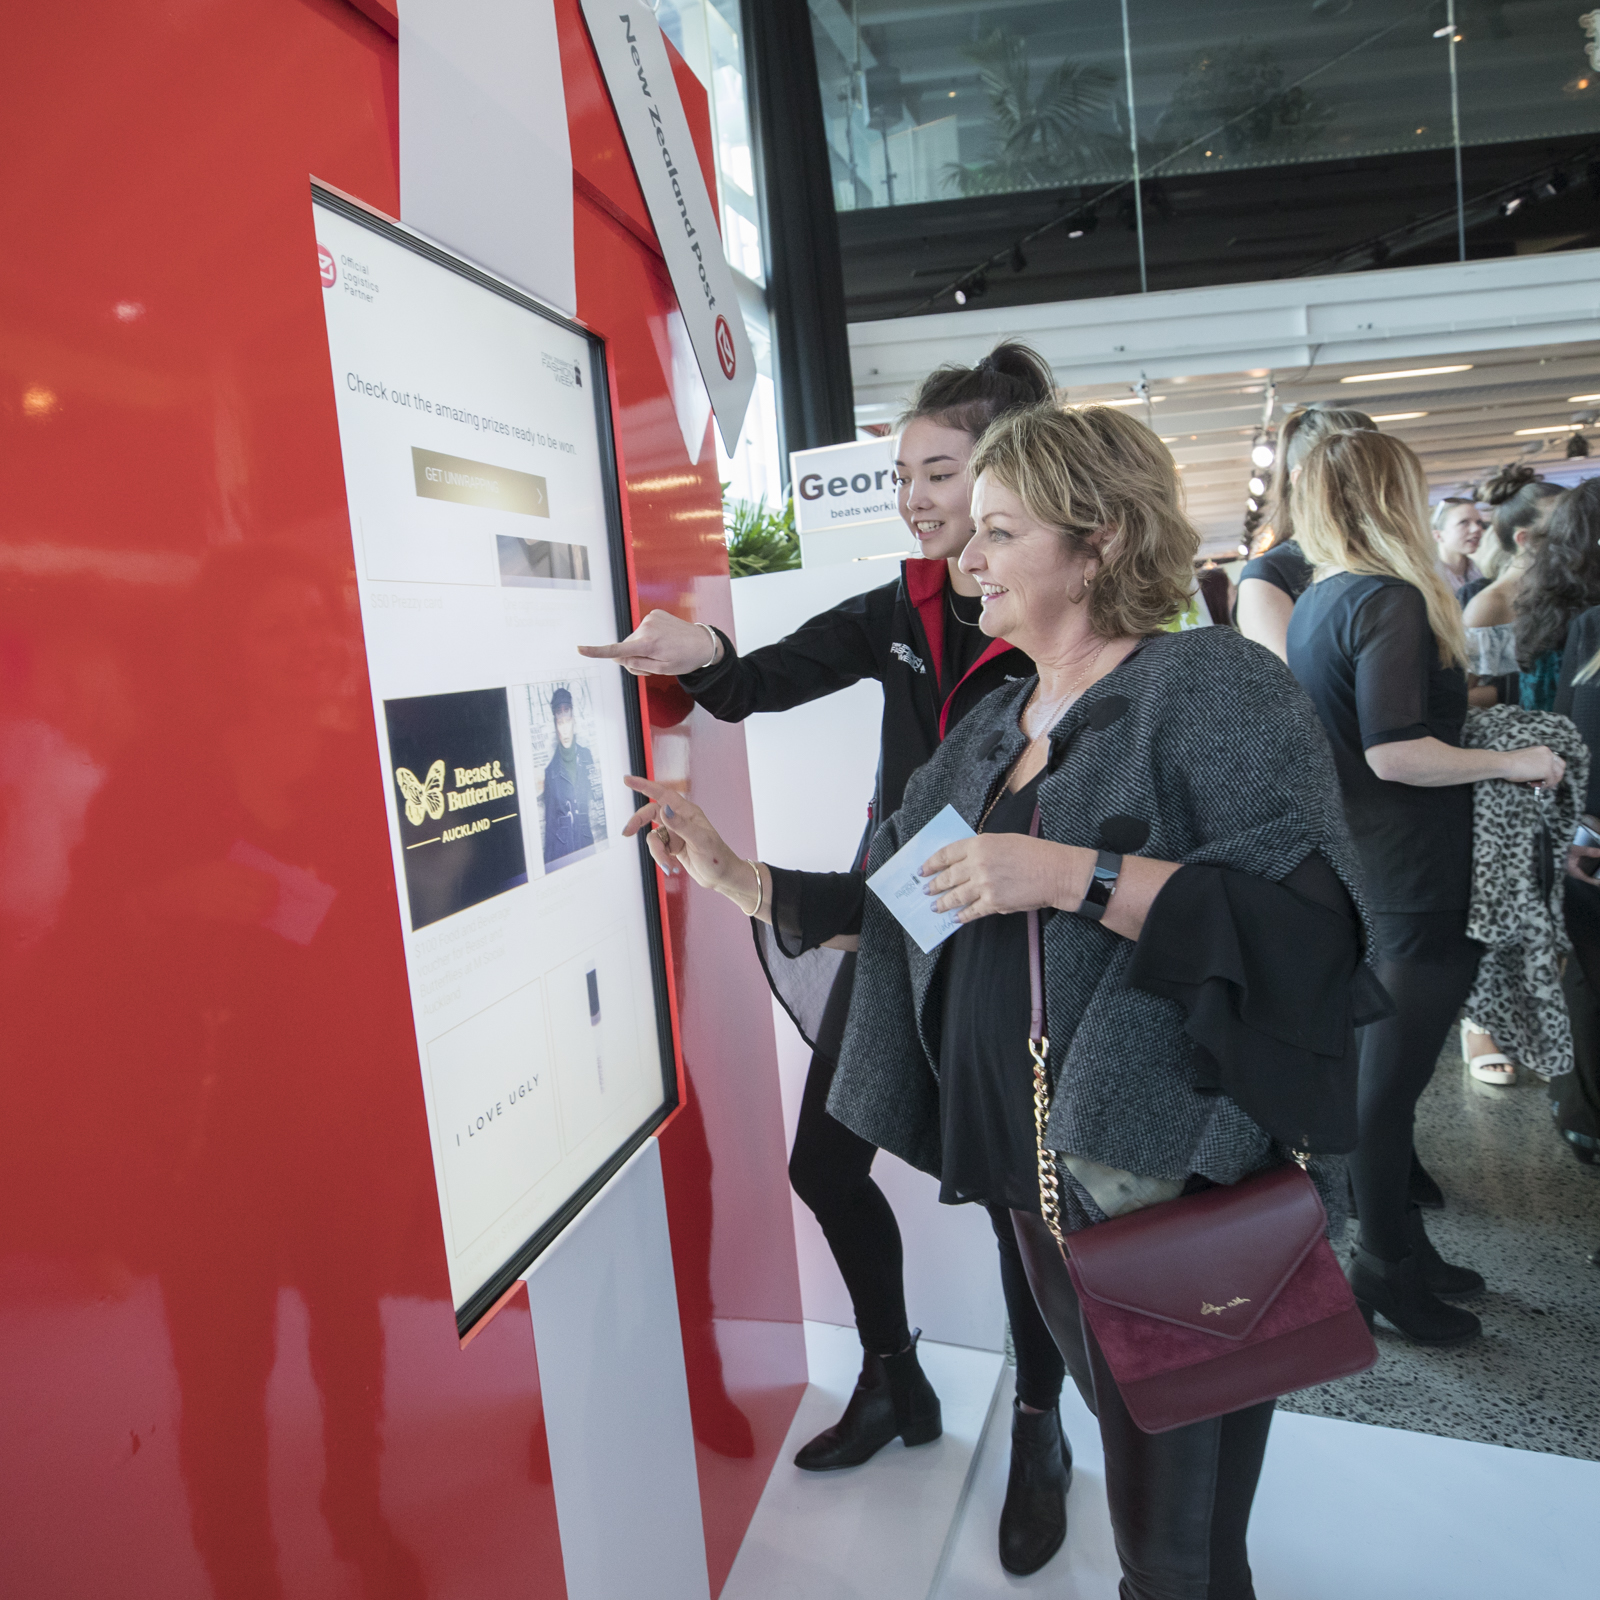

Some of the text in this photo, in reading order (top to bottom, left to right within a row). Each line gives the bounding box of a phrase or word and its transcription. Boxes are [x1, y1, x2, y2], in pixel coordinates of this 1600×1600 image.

[618, 14, 716, 310] New Zealand Post
[340, 254, 369, 275] Official
[342, 268, 380, 293] Logistics
[343, 282, 374, 303] Partner
[541, 358, 574, 379] FASHION
[554, 373, 575, 388] WEEK
[346, 372, 577, 455] Check out the amazing prizes ready to be won.
[425, 466, 500, 494] GET UNWRAPPING
[830, 507, 861, 518] beats
[370, 593, 443, 611] $50 Prezzy card
[453, 760, 505, 788] Beast &
[446, 779, 515, 812] Butterflies
[442, 818, 491, 844] AUCKLAND
[414, 937, 437, 959] $100
[438, 926, 460, 947] Food
[461, 920, 477, 937] and
[477, 906, 512, 930] Beverage
[417, 953, 450, 977] voucher
[465, 935, 488, 954] Beast
[423, 986, 461, 1018] Auckland
[456, 1073, 539, 1147] I LOVE UGLY
